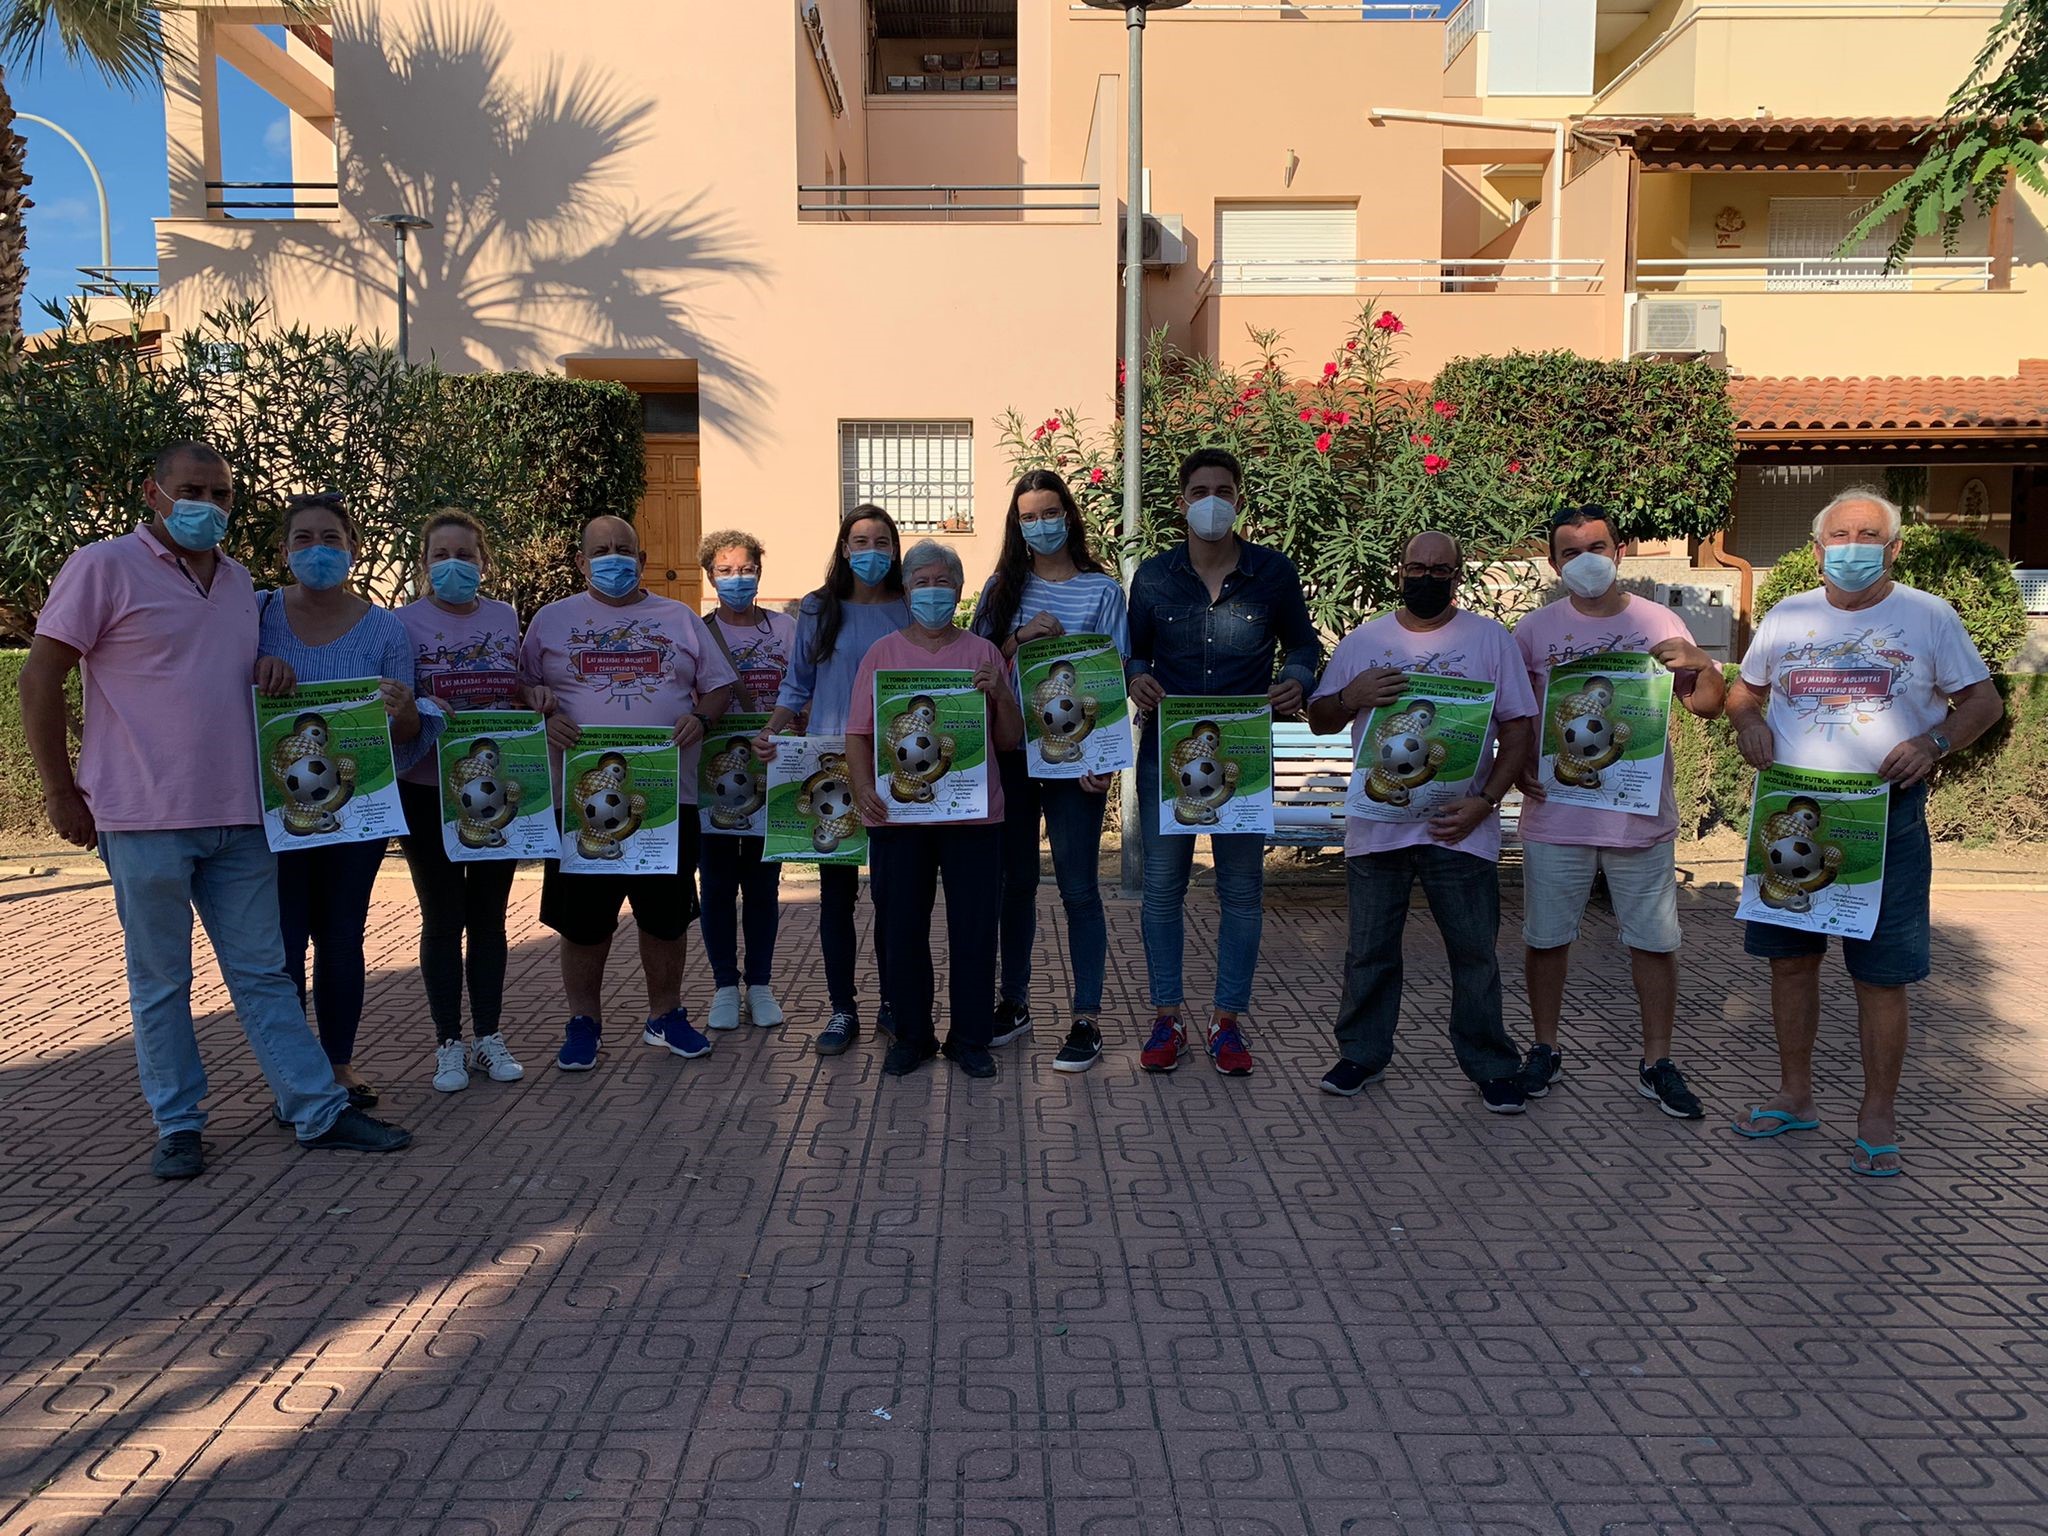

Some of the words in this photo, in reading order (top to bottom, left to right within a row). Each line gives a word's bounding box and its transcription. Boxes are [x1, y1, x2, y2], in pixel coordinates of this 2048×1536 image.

[1763, 777, 1792, 787] NICOLASA
[1773, 770, 1795, 780] TORNEO
[1804, 776, 1831, 785] FUTBOL
